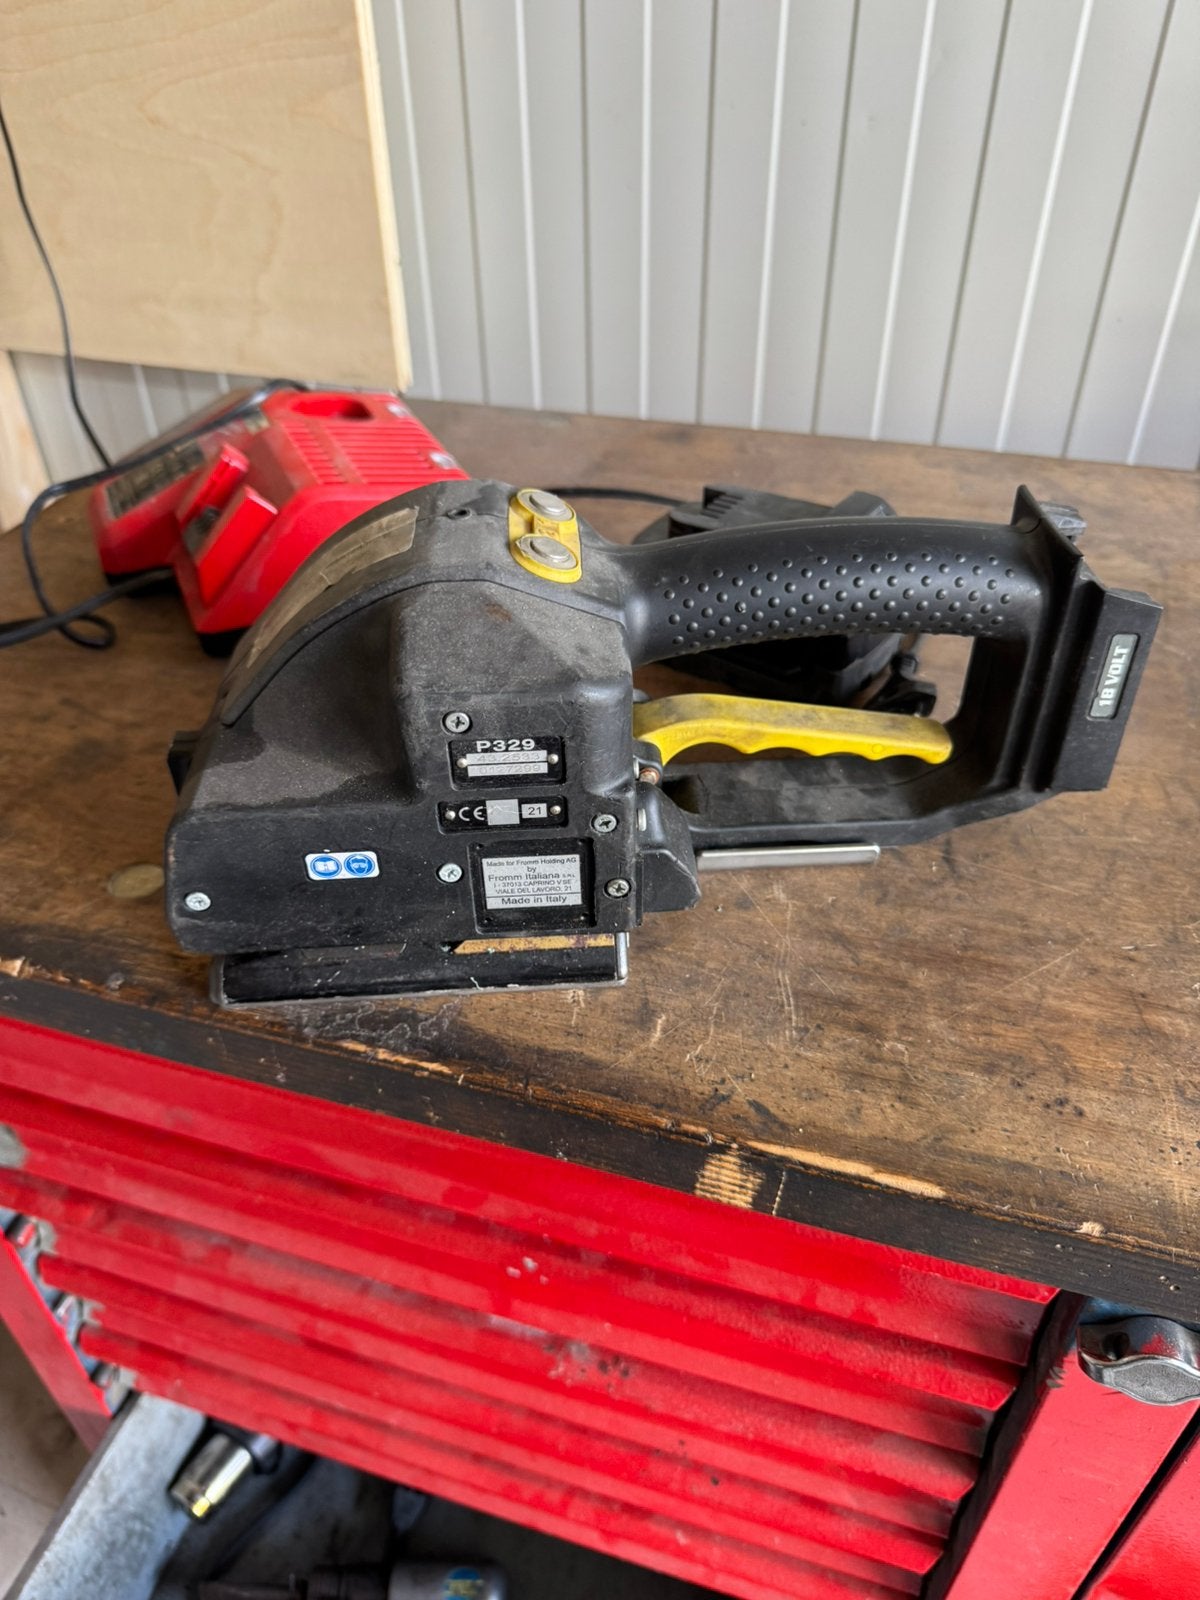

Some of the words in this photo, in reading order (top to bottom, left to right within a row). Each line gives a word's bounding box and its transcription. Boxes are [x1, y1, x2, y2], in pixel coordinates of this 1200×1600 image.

[1104, 645, 1129, 686] VOLT
[1099, 688, 1116, 706] 18
[476, 738, 535, 752] P329
[458, 806, 485, 821] CE
[527, 806, 542, 816] 21
[541, 857, 565, 865] Holding
[488, 874, 522, 882] Fromm
[525, 872, 560, 881] Italiana
[523, 879, 555, 887] CAPRINO
[501, 897, 530, 905] Made
[546, 895, 567, 904] Italy
